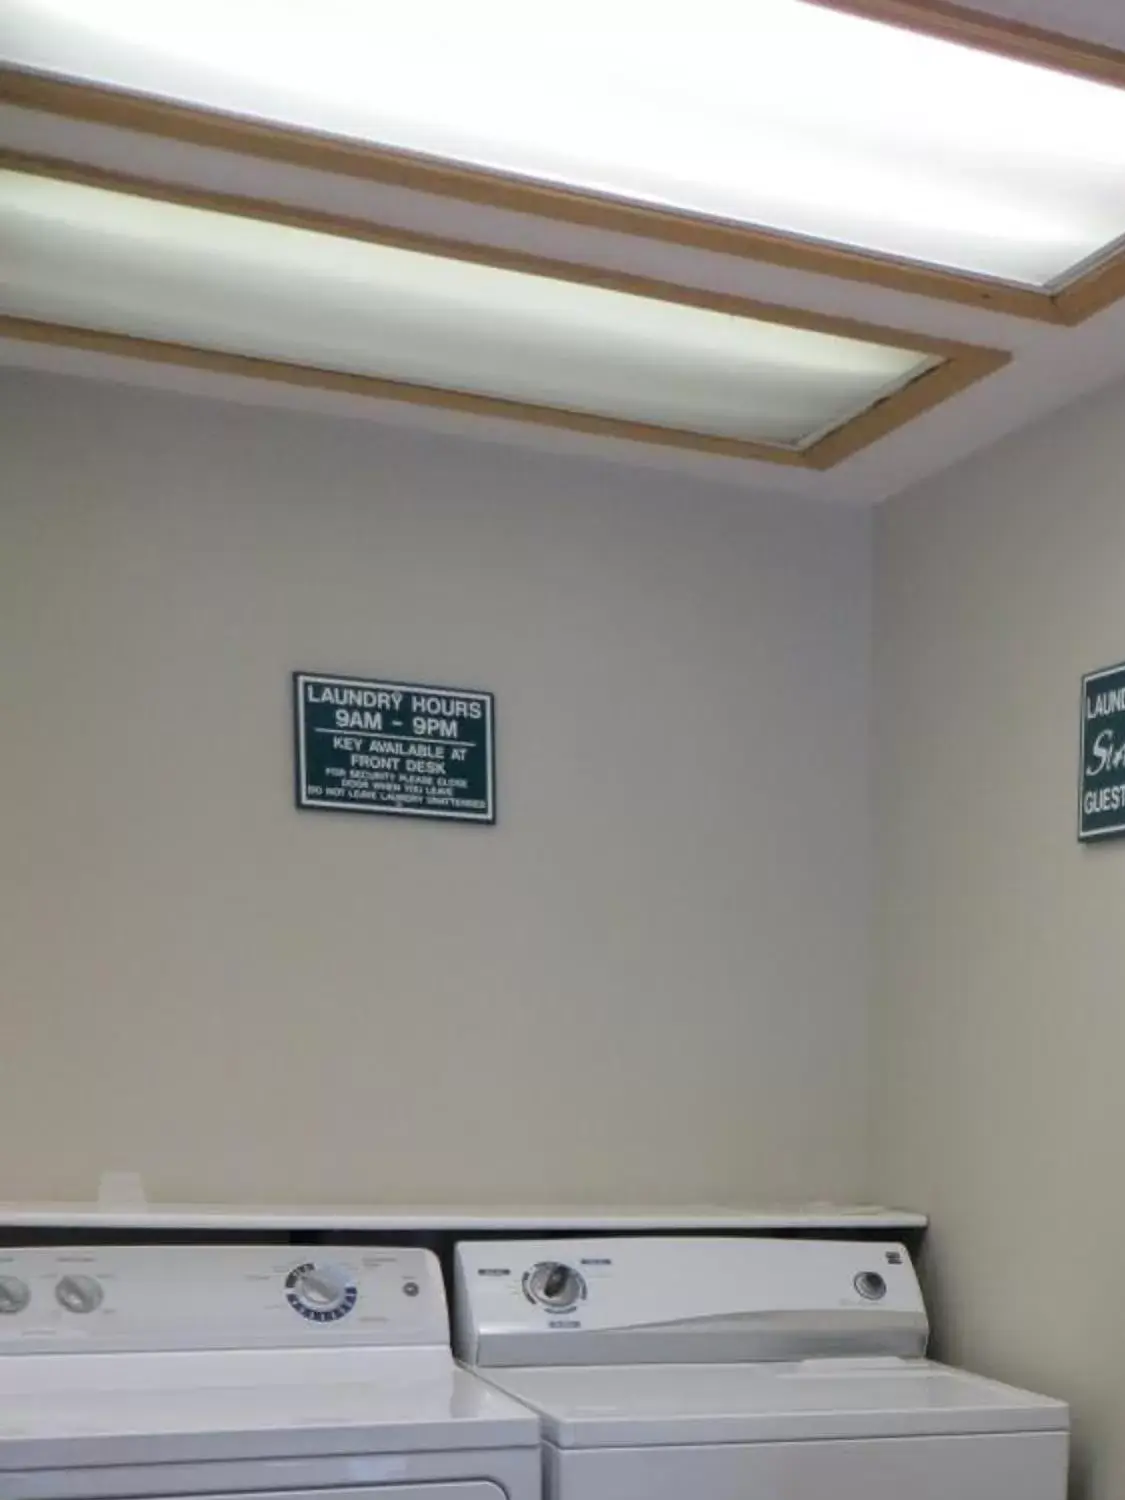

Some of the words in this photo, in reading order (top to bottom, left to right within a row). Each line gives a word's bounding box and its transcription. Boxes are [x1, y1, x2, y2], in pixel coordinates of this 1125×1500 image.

[307, 684, 403, 711] LAUNDRY
[412, 696, 482, 719] HOURS
[335, 708, 382, 730] 9AM
[413, 716, 458, 738] 9PM
[333, 736, 363, 751] KEY
[369, 740, 444, 760] AVAILABLE
[451, 748, 468, 761] AT
[351, 754, 400, 770] FRONT
[406, 760, 446, 774] DESK
